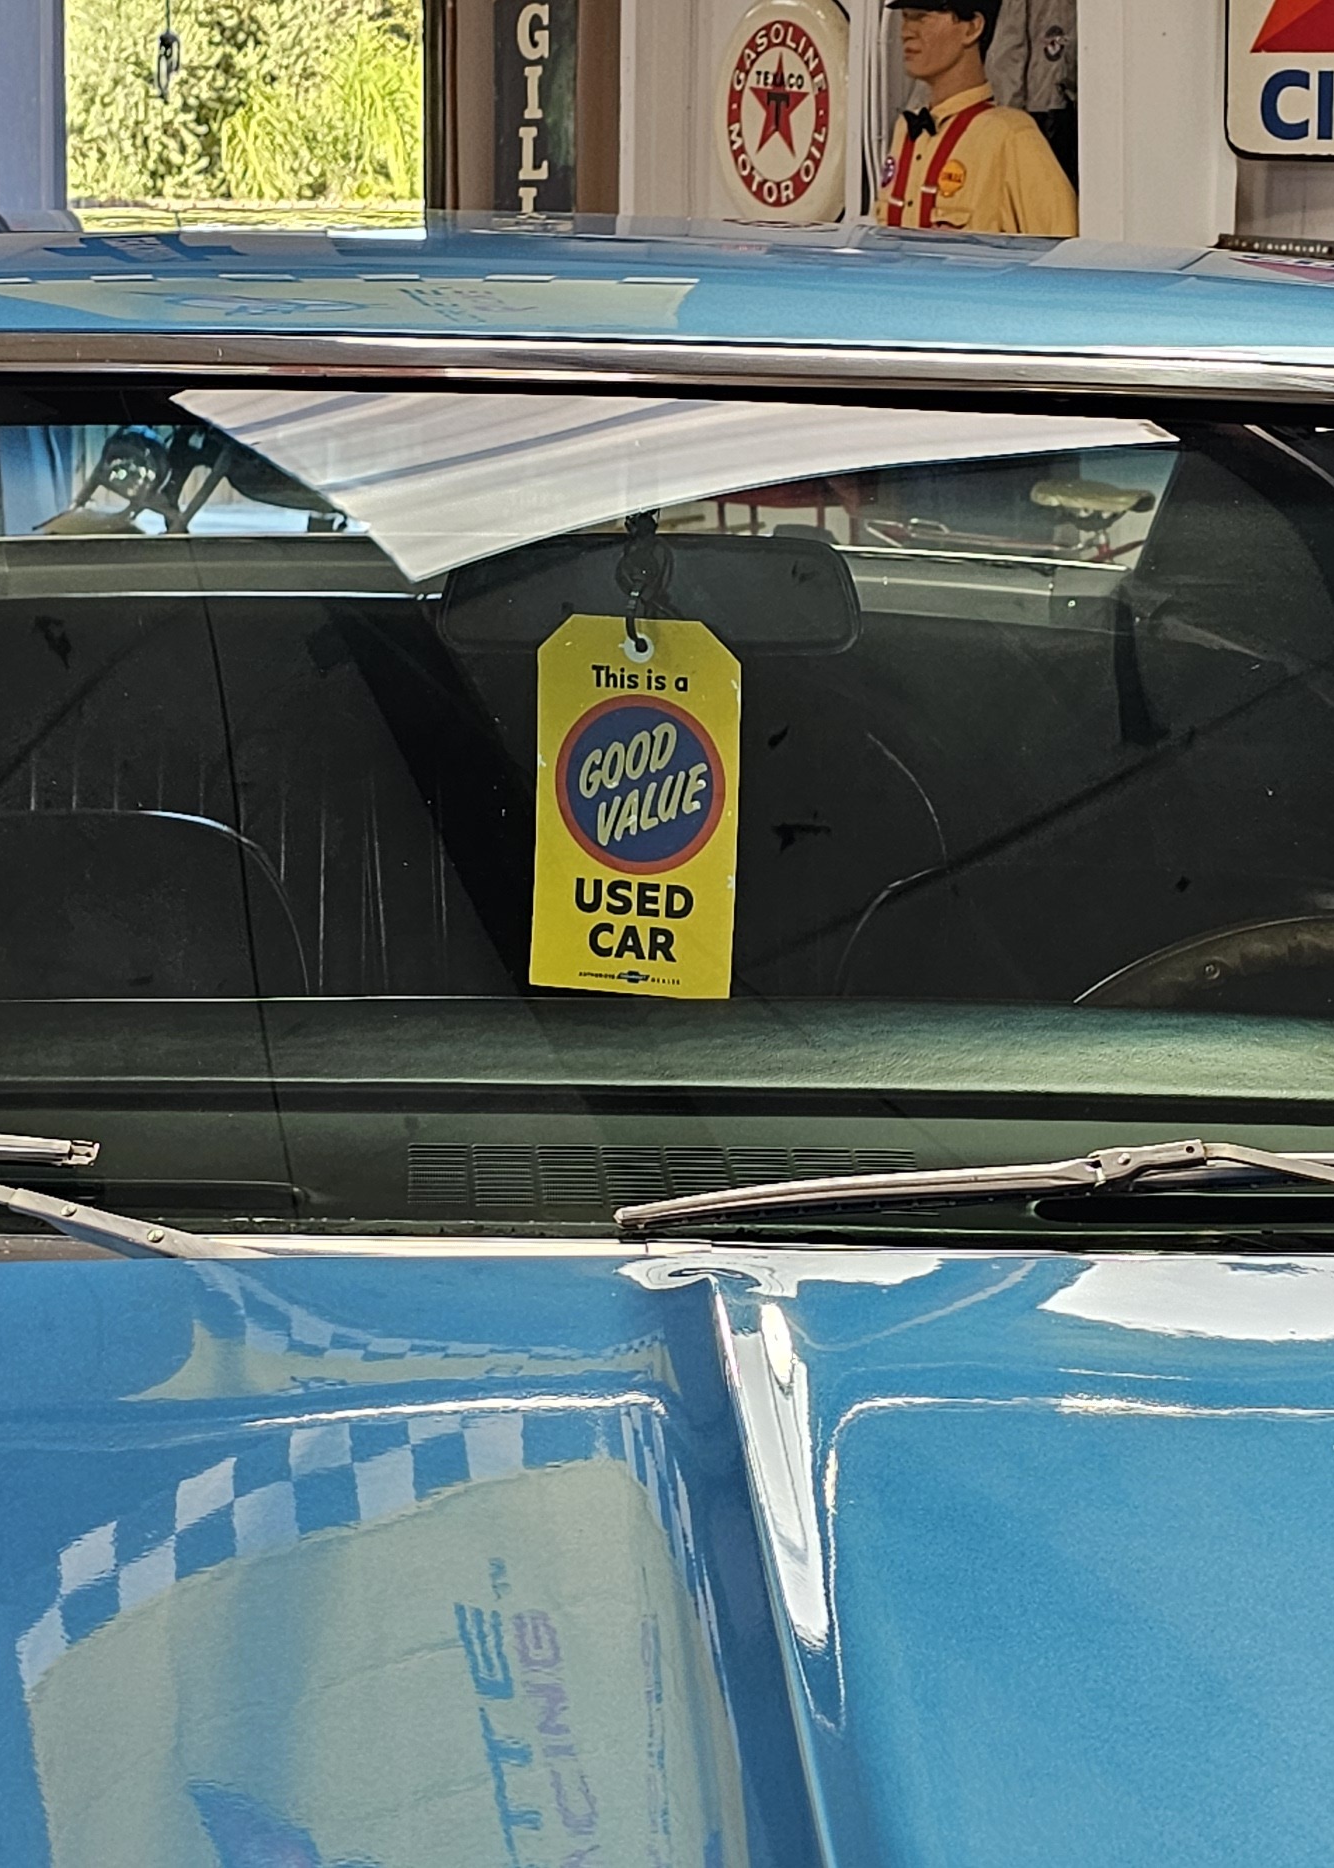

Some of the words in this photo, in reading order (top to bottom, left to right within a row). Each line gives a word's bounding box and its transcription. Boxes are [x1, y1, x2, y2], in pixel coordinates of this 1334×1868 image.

[733, 23, 827, 96] GASOLINE
[756, 70, 805, 91] TEXACO
[729, 122, 795, 204] MOTOR
[800, 127, 826, 183] OIL
[591, 664, 639, 689] This
[646, 668, 666, 690] is
[674, 676, 689, 692] a
[579, 722, 677, 798] GOOD
[597, 762, 707, 846] VALUE
[575, 877, 694, 919] USED
[588, 923, 677, 963] CAR
